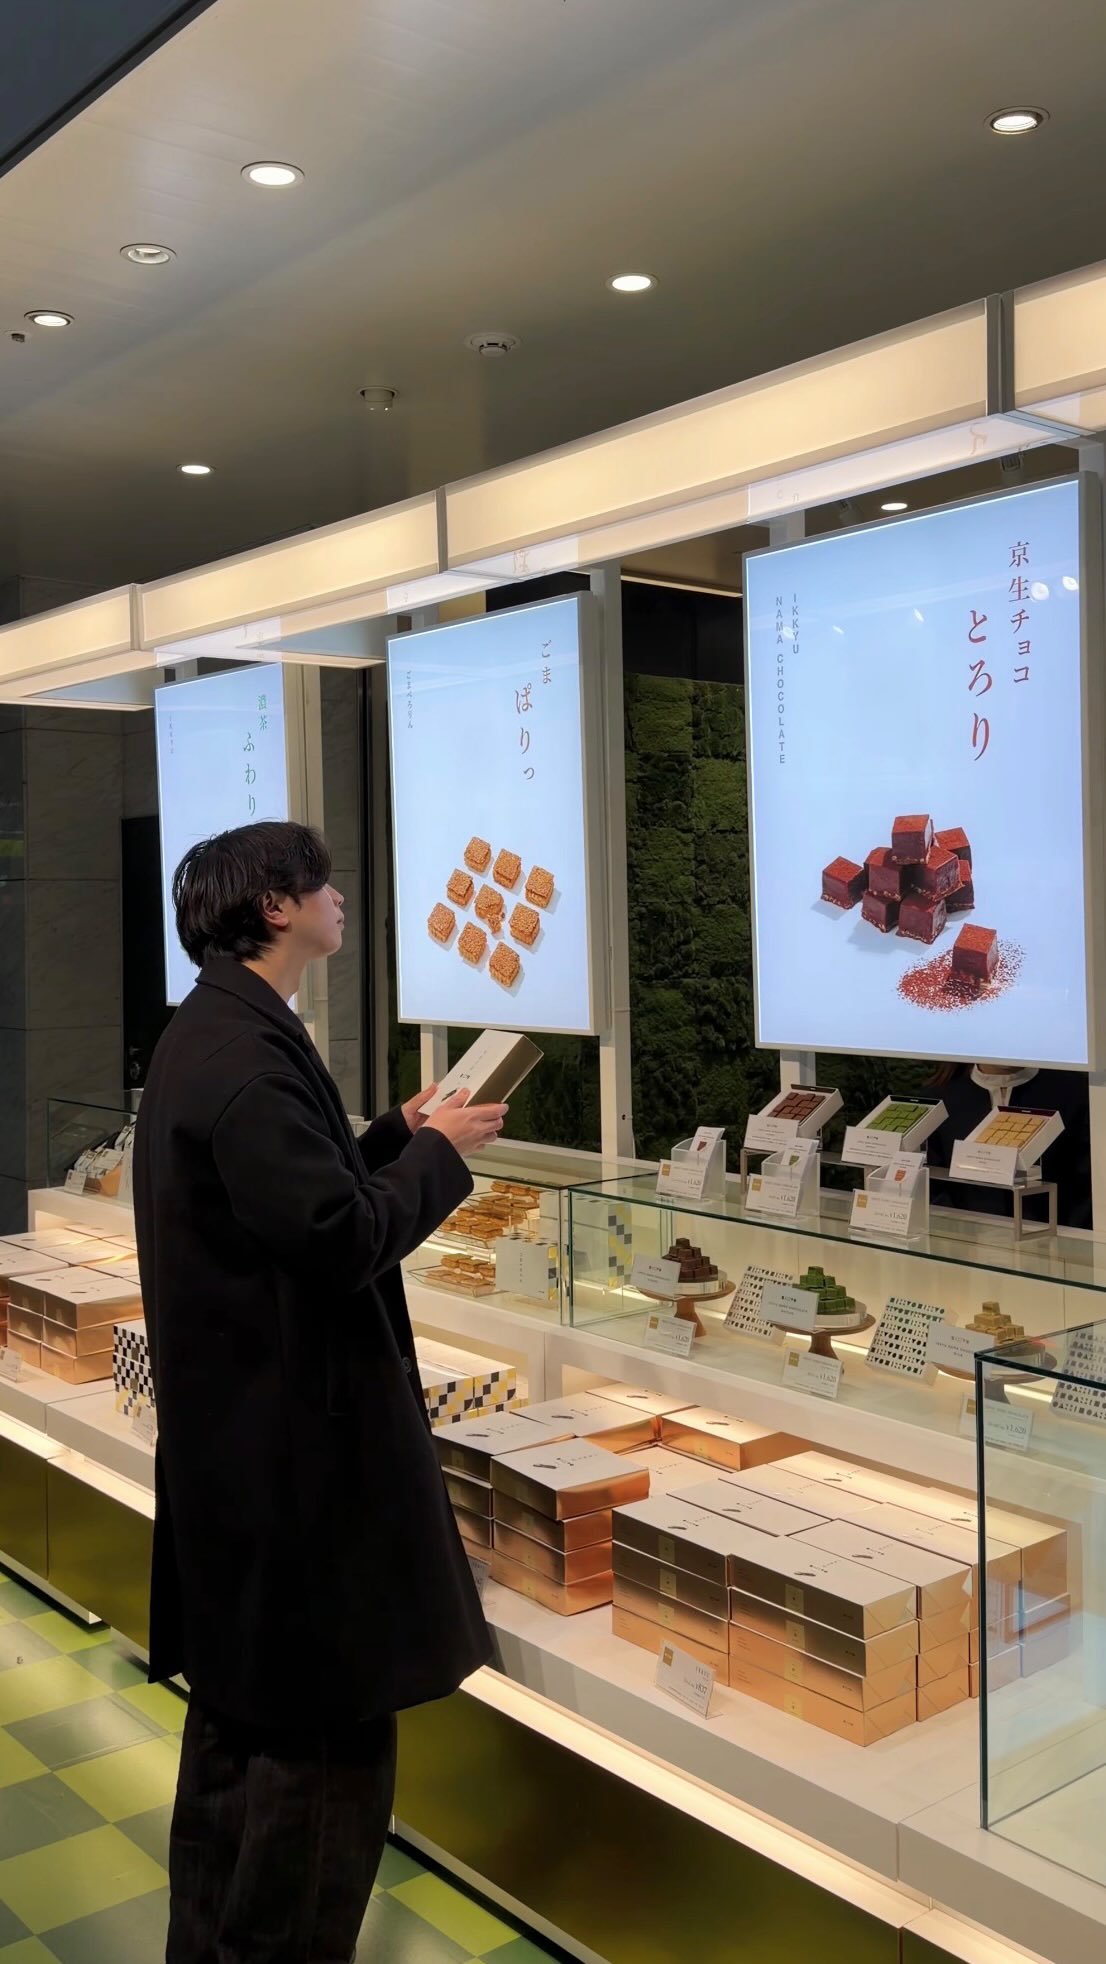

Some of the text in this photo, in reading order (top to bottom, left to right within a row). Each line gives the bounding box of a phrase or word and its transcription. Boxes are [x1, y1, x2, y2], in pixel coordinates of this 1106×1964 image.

[791, 593, 800, 655] IKKYU
[1008, 541, 1031, 683] 京生チョコ
[541, 639, 552, 684] ごま
[775, 597, 786, 764] NAMA CHOCOLATE
[967, 609, 993, 761] とろり
[243, 732, 257, 816] ふわり
[514, 682, 535, 780] ぱりっ
